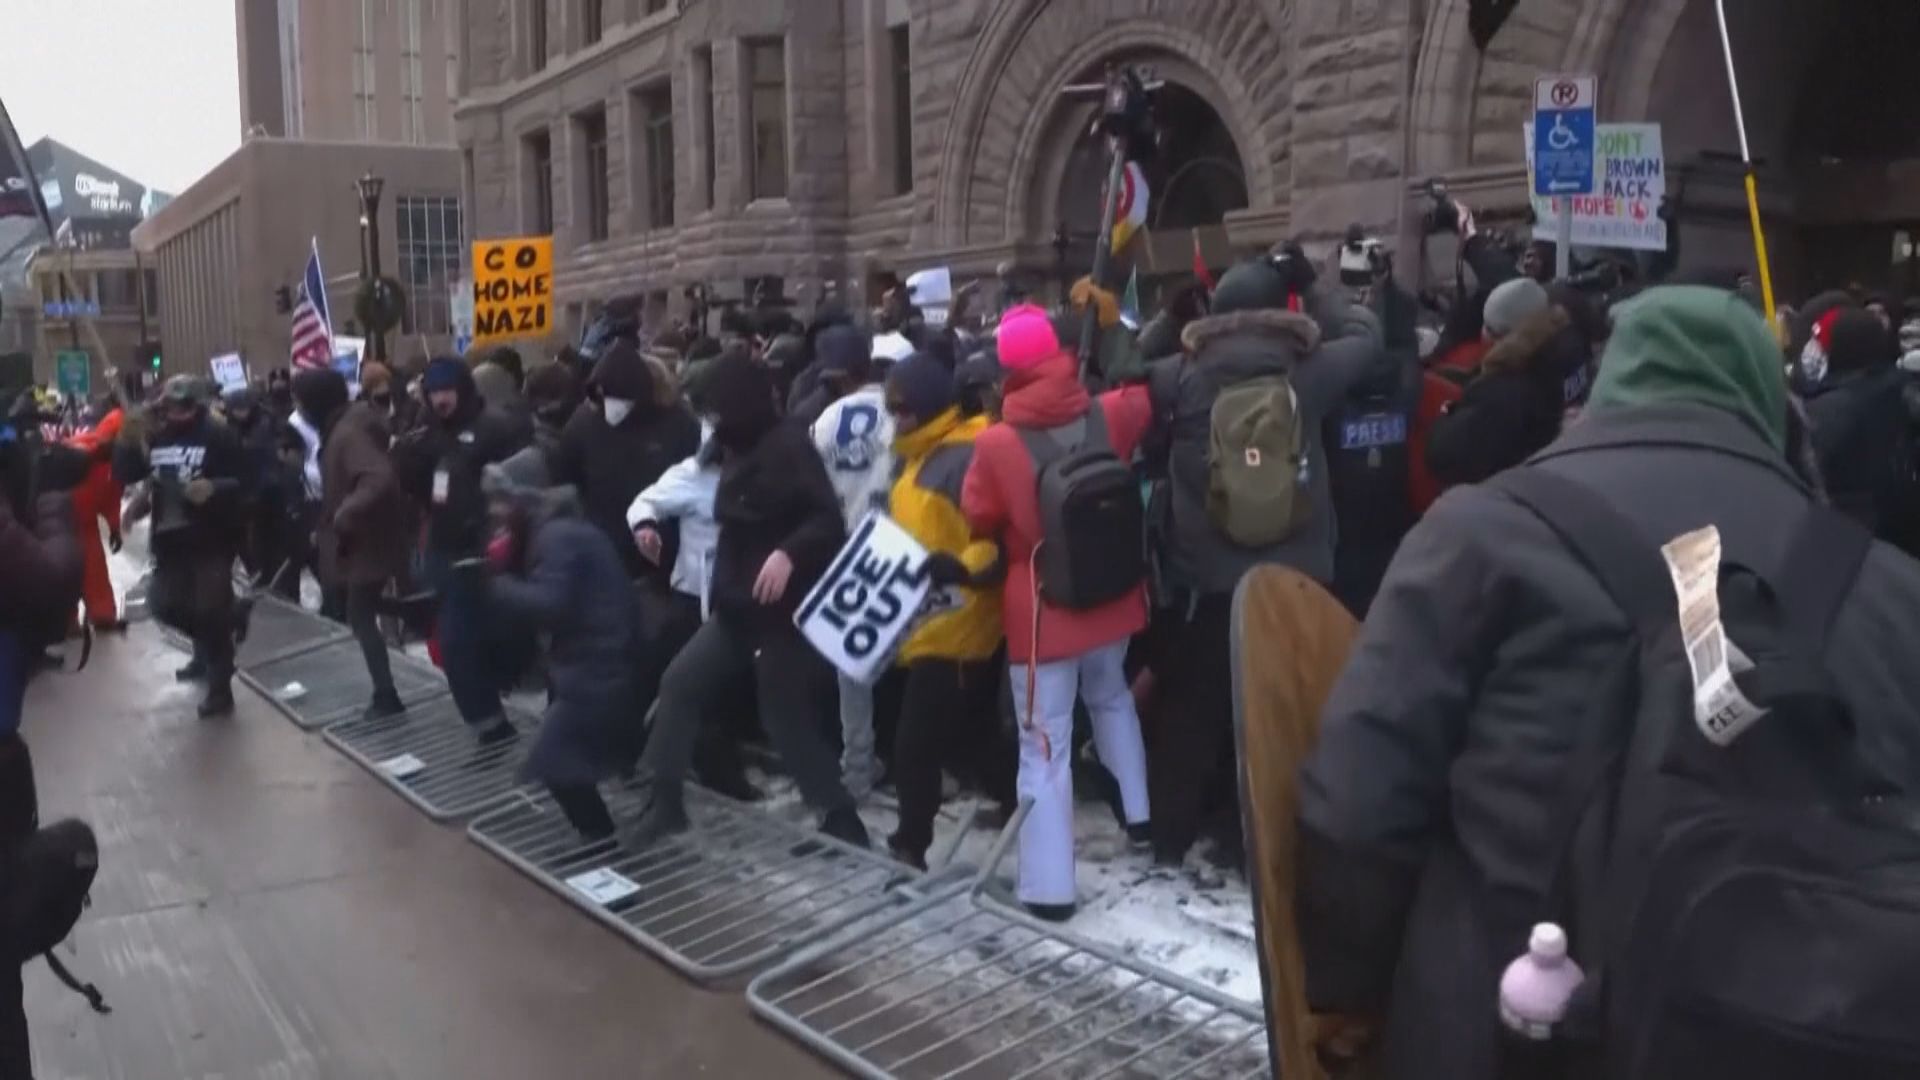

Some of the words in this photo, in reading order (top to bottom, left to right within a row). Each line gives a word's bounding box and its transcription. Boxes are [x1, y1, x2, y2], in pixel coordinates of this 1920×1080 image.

[1605, 157, 1660, 178] BROWN
[1604, 180, 1651, 199] BACK
[474, 273, 549, 302] HOME
[476, 303, 545, 336] NAZI
[1345, 414, 1405, 446] PRESS
[820, 547, 891, 631] ICE
[843, 555, 930, 659] OUT
